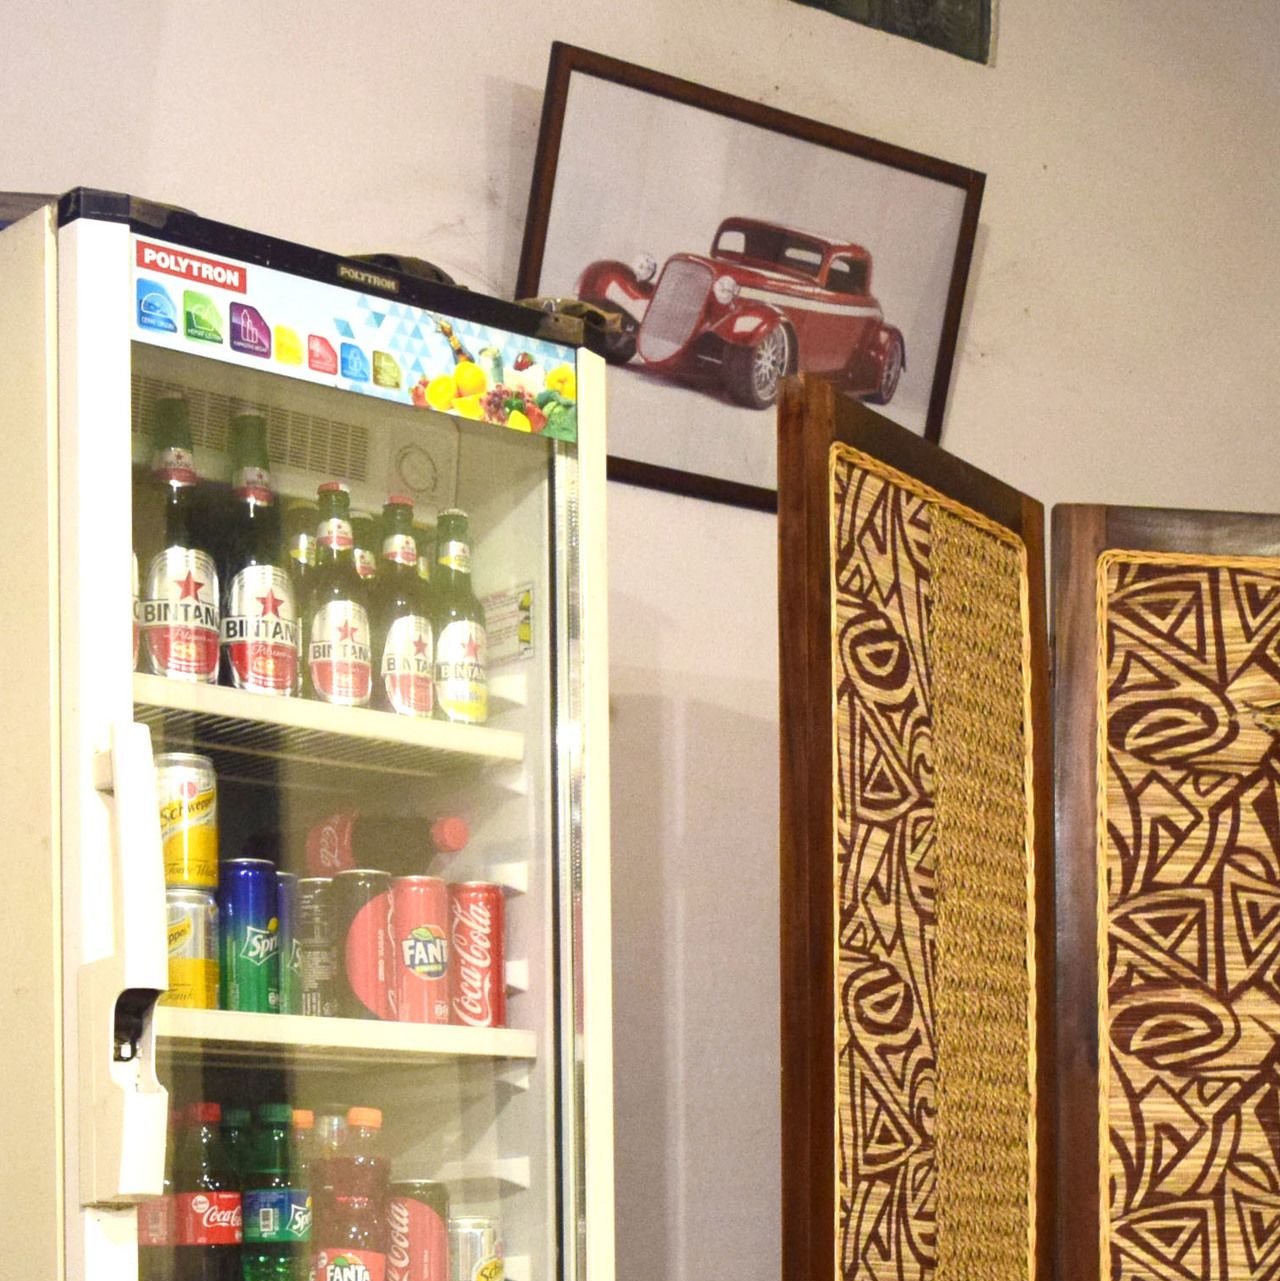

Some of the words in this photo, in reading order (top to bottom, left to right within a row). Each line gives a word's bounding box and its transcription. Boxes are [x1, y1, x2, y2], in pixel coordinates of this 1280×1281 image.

[143, 247, 240, 287] POLYTRON
[339, 265, 397, 291] POLYTRON
[402, 939, 448, 965] FANT
[452, 896, 493, 1028] Coca-Cola
